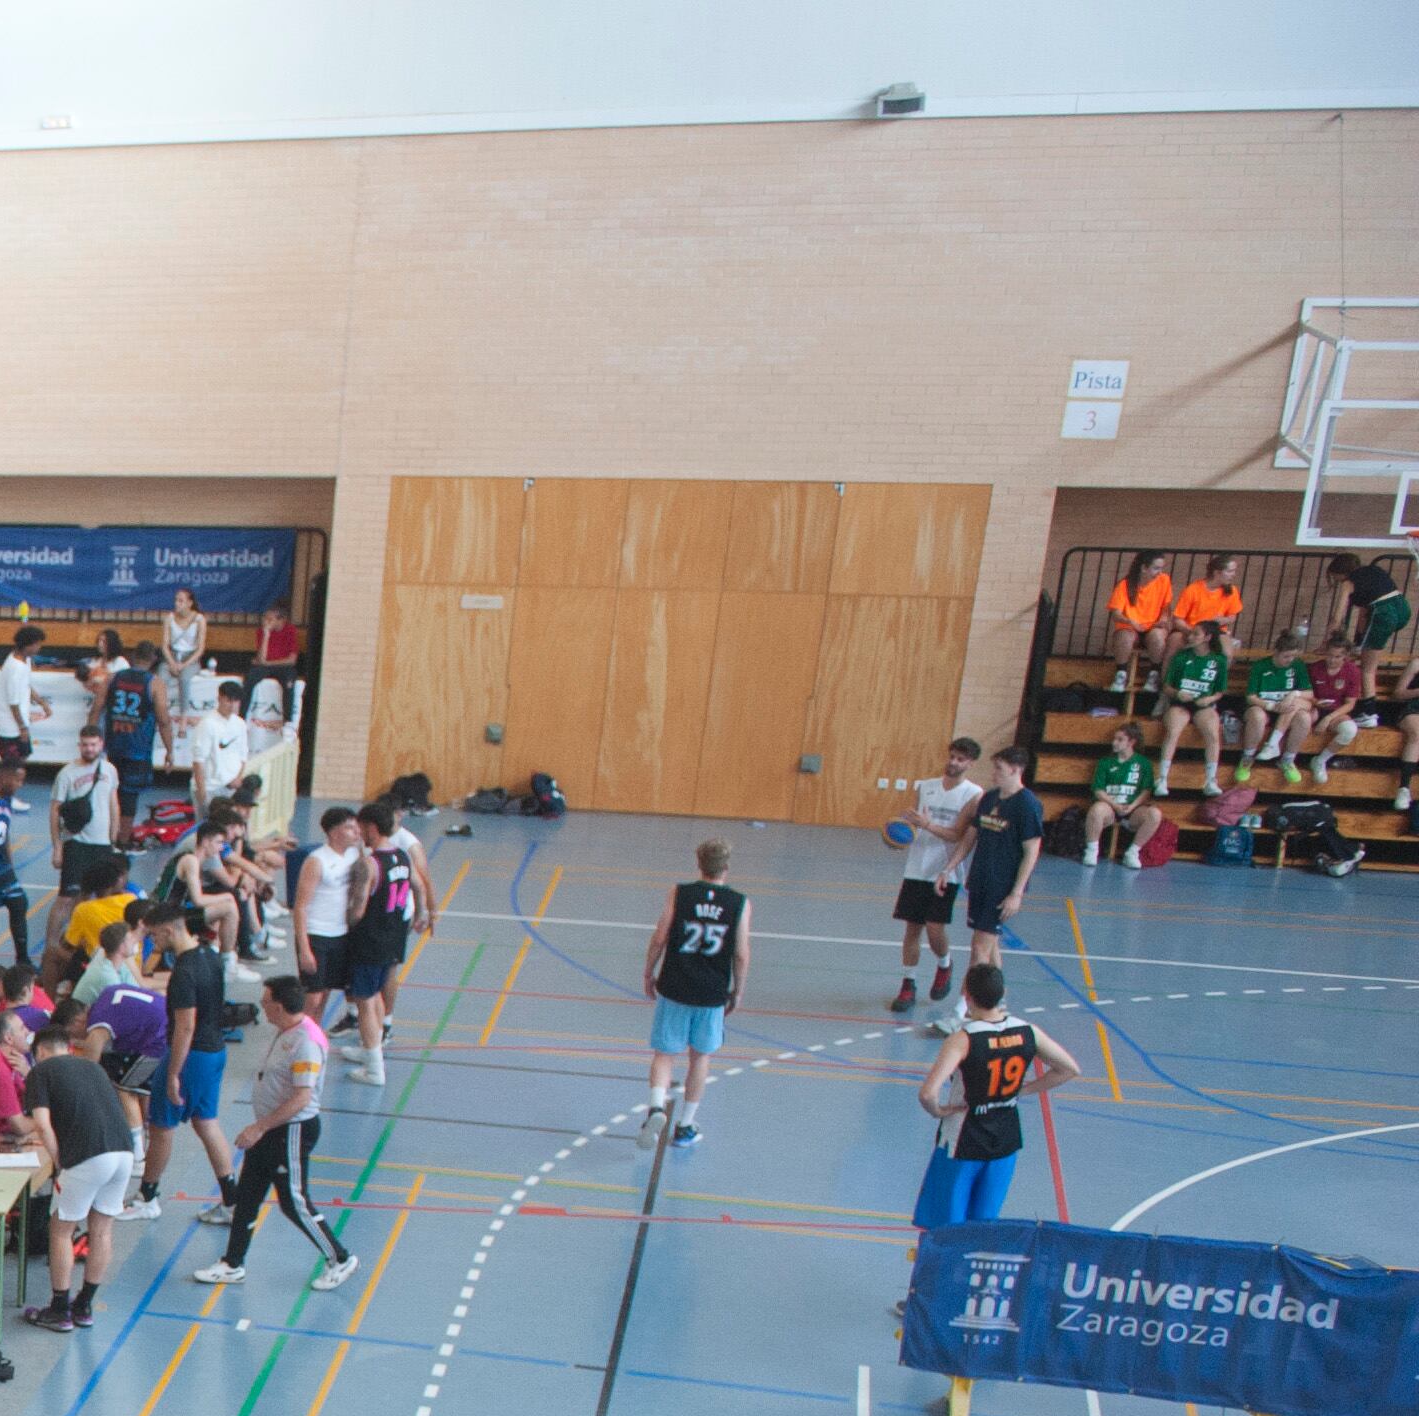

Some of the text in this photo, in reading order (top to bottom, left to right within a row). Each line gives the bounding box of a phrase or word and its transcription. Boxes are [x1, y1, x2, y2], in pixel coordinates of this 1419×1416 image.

[1073, 371, 1122, 389] Pista
[1082, 410, 1097, 431] 3
[153, 546, 274, 569] Universidad
[153, 568, 230, 587] Zaragoza
[112, 689, 141, 718] 32
[679, 921, 730, 957] 25
[987, 1055, 1026, 1099] 19
[1062, 1261, 1340, 1331] Universidad
[1055, 1303, 1230, 1348] Zaragoza
